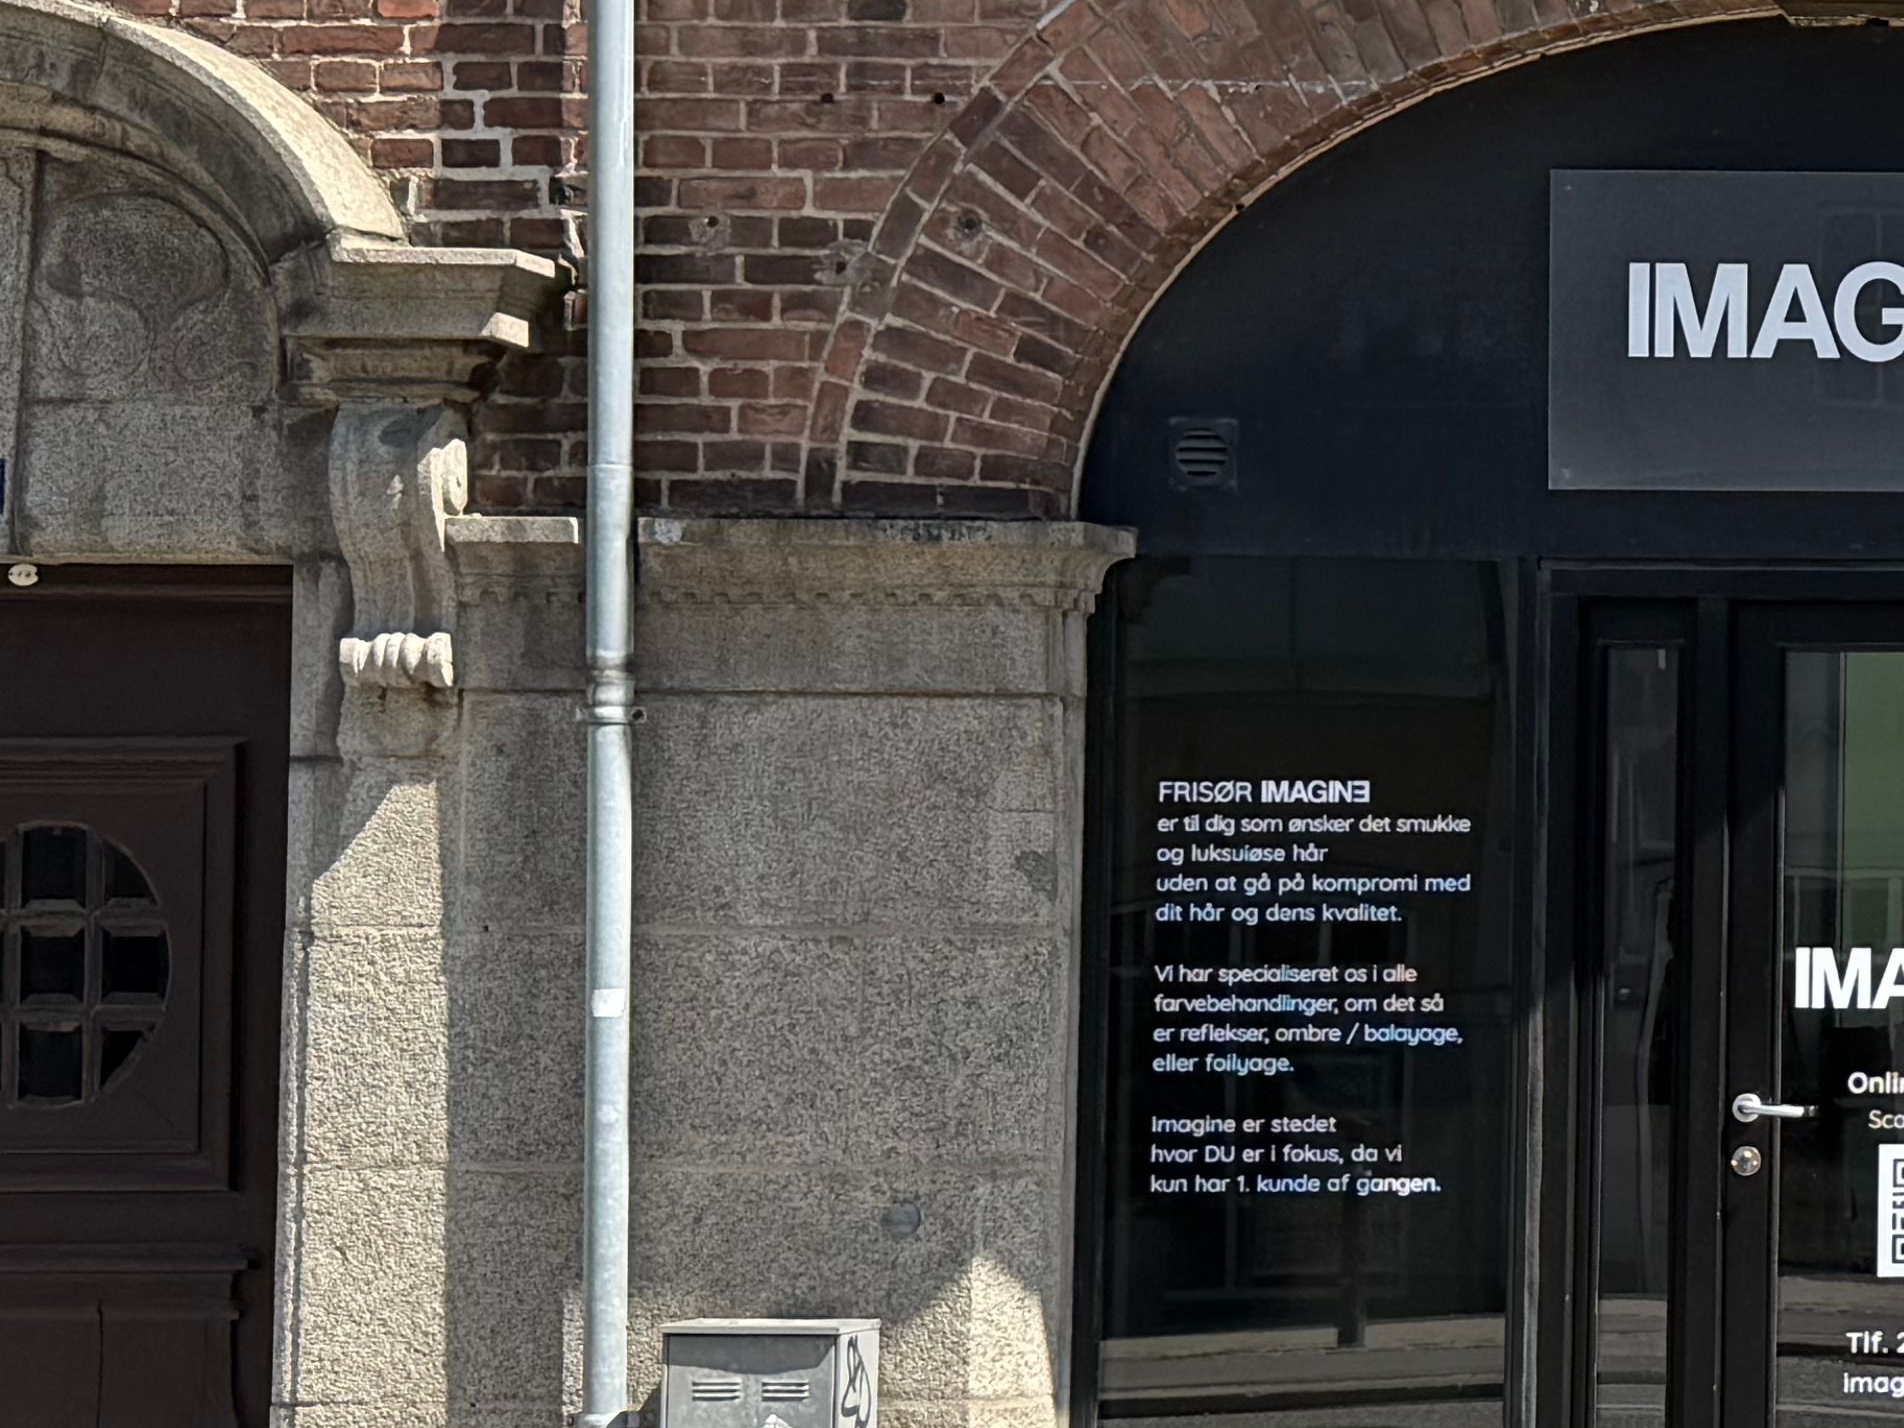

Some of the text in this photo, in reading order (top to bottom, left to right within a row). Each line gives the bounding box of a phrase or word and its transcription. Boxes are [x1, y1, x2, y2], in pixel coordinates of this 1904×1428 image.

[1159, 780, 1371, 803] FRISØR IMAGINE
[1157, 813, 1472, 836] er til dig som ønsker det smukke
[1157, 848, 1185, 867] og
[1293, 843, 1329, 862] hår
[1156, 871, 1472, 897] uden at gå på kompromi med
[1155, 902, 1403, 926] dit hår og dens kvalitet.
[1154, 964, 1419, 987] Vi har specialiseret os i alle
[1154, 992, 1445, 1017] farvebehandlinger, om det så
[1153, 1028, 1176, 1042] er
[1180, 1023, 1270, 1045] reflekser,
[1275, 1024, 1343, 1042] ombre
[1364, 1023, 1464, 1047] balayage,
[1152, 1053, 1295, 1077] eller foilyage.
[1152, 1114, 1337, 1137] Imagine er stedet
[1151, 1144, 1403, 1165] hvor DU er i fokus, da vi
[1151, 1174, 1442, 1197] kun har 1. kunde af gangen.
[1846, 1330, 1889, 1354] Tlf.
